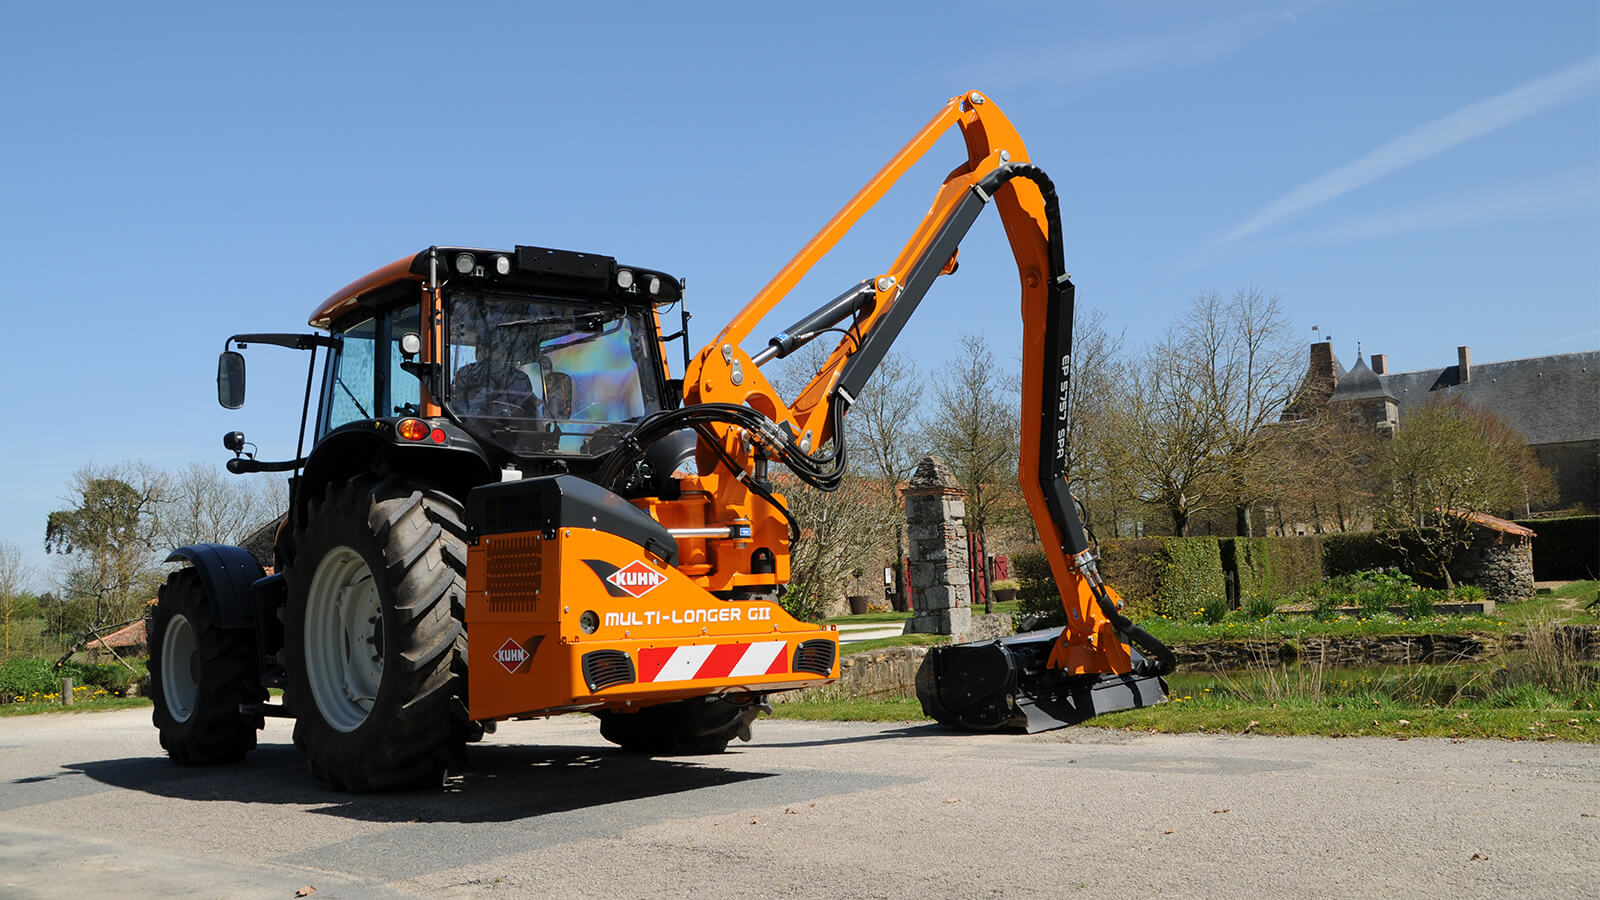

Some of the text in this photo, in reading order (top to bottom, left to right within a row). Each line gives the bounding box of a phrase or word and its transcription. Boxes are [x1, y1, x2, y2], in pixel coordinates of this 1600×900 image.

[1056, 355, 1070, 459] EP 5757 SPA
[615, 571, 659, 586] KUHN
[605, 607, 771, 627] MULTI-LONGER GII
[498, 649, 525, 662] KUHN
